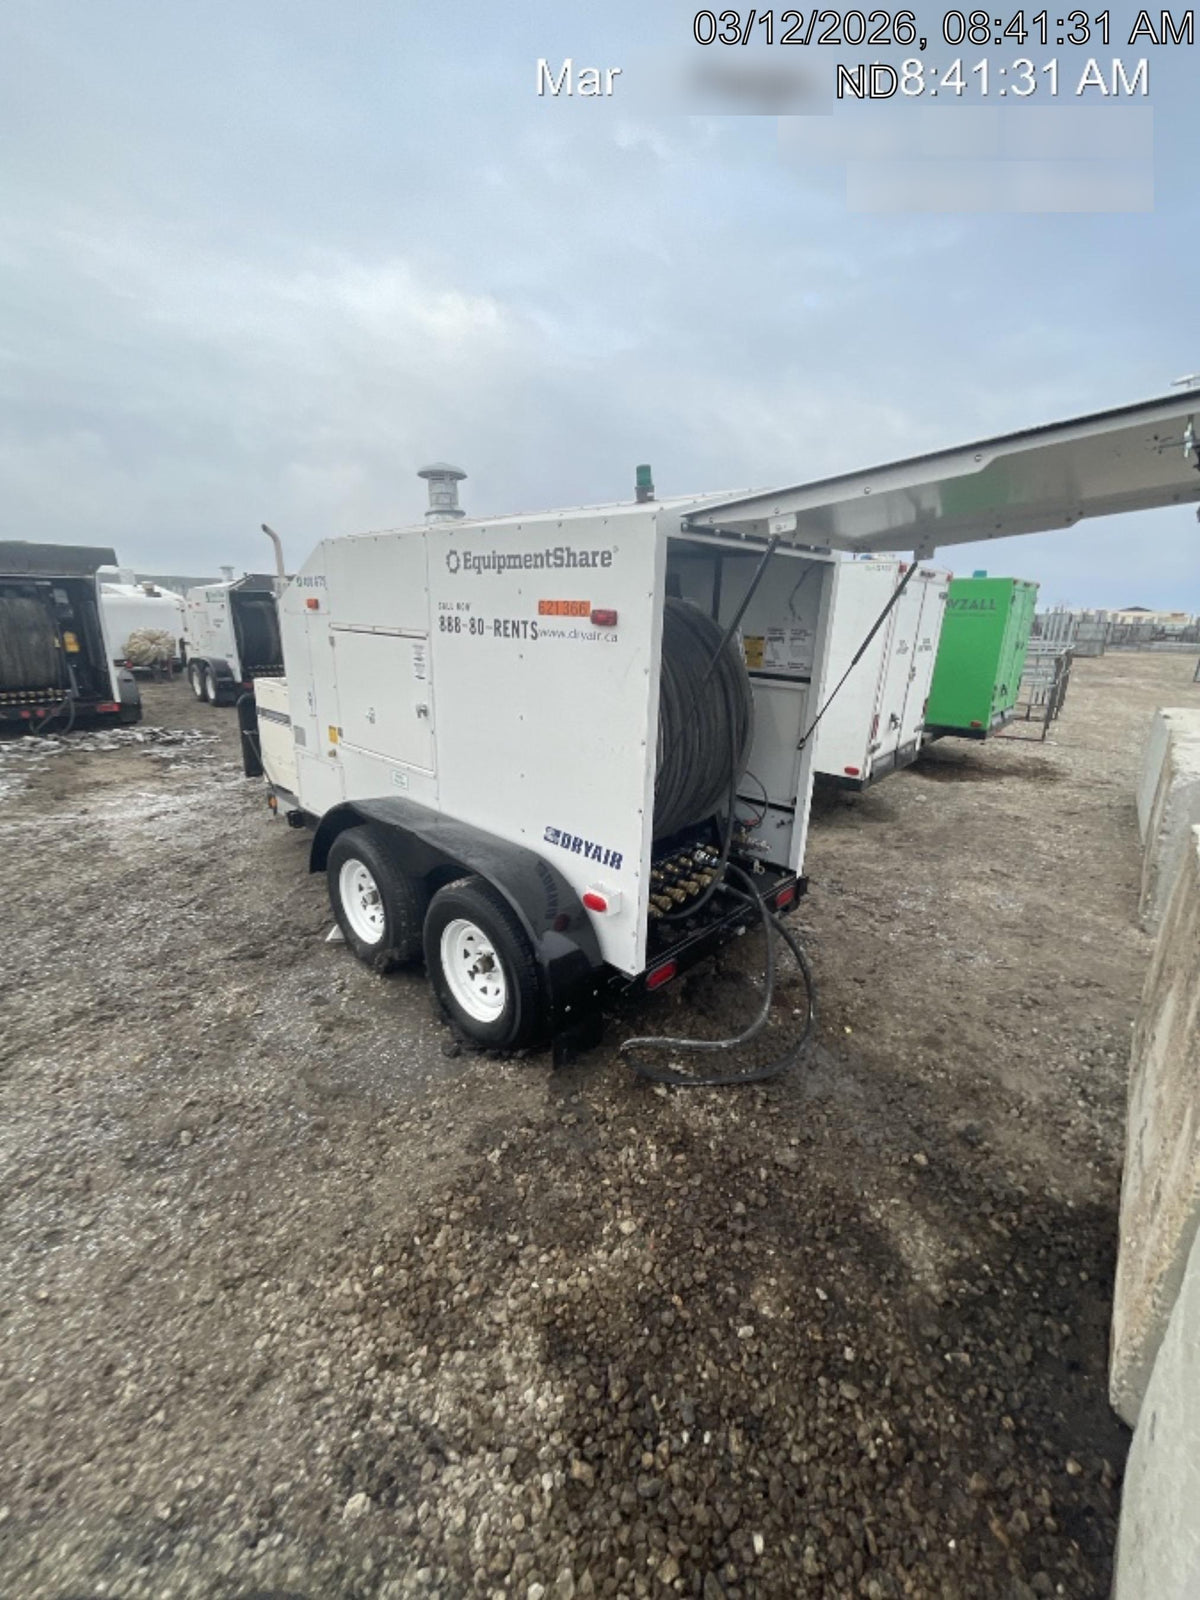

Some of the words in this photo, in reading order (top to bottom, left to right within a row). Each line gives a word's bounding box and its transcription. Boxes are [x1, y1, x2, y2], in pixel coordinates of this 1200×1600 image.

[463, 547, 612, 574] EquipmentShare
[538, 600, 590, 617] 621366
[438, 615, 538, 640] 888-80-RENTS
[539, 629, 618, 643] www.dryair.ca
[560, 832, 623, 870] DRYAIR
